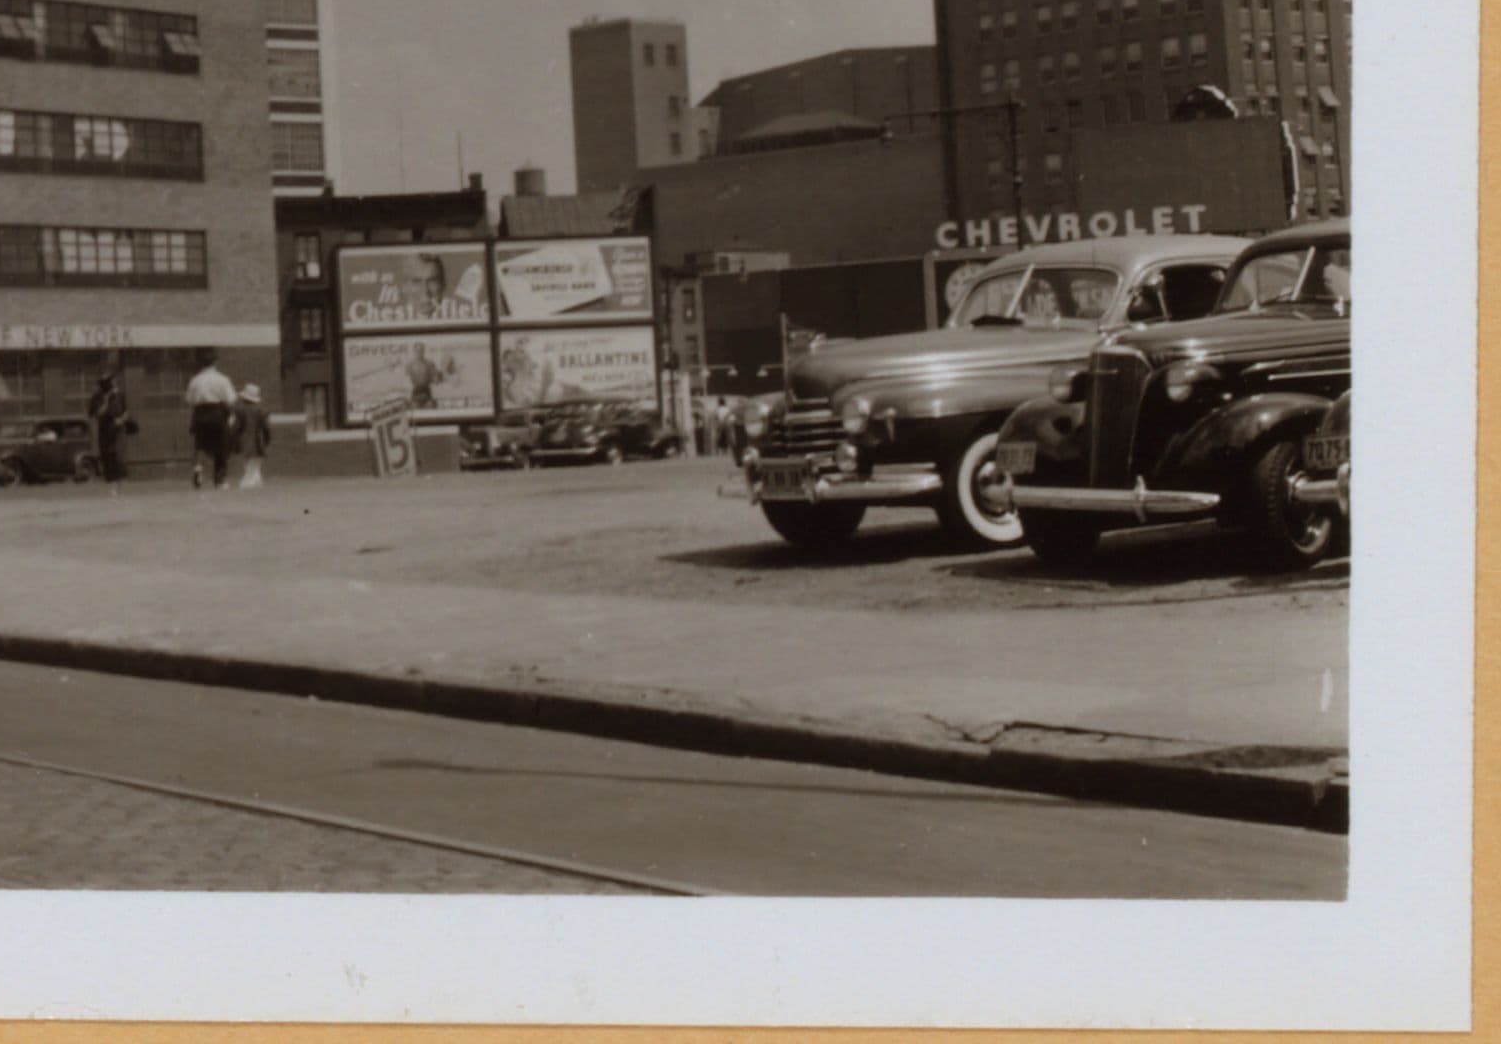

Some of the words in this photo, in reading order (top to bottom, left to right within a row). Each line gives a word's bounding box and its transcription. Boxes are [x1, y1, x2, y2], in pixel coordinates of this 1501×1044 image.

[936, 205, 1207, 247] CHEVROLET
[26, 326, 72, 349] NEW
[84, 325, 133, 348] YORK
[376, 419, 409, 472] 15
